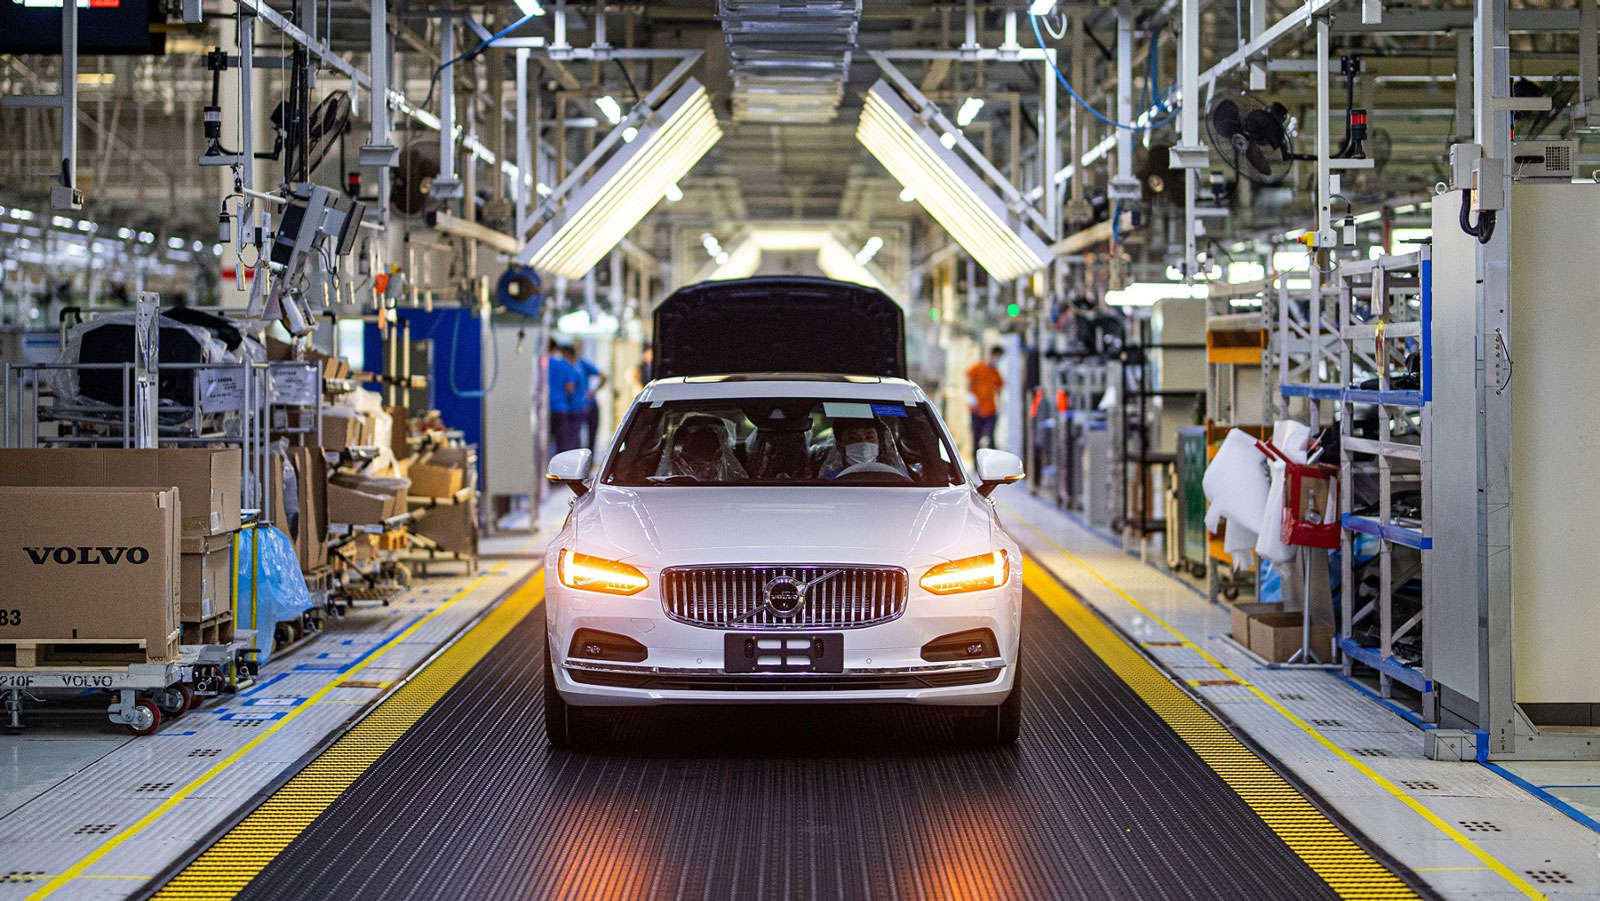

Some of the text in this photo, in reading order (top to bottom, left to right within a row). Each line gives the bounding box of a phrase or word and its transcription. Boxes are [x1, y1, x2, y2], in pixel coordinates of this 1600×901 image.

[23, 546, 149, 565] VOLVO
[0, 609, 21, 626] 83
[0, 675, 113, 687] 210F VOLVO
